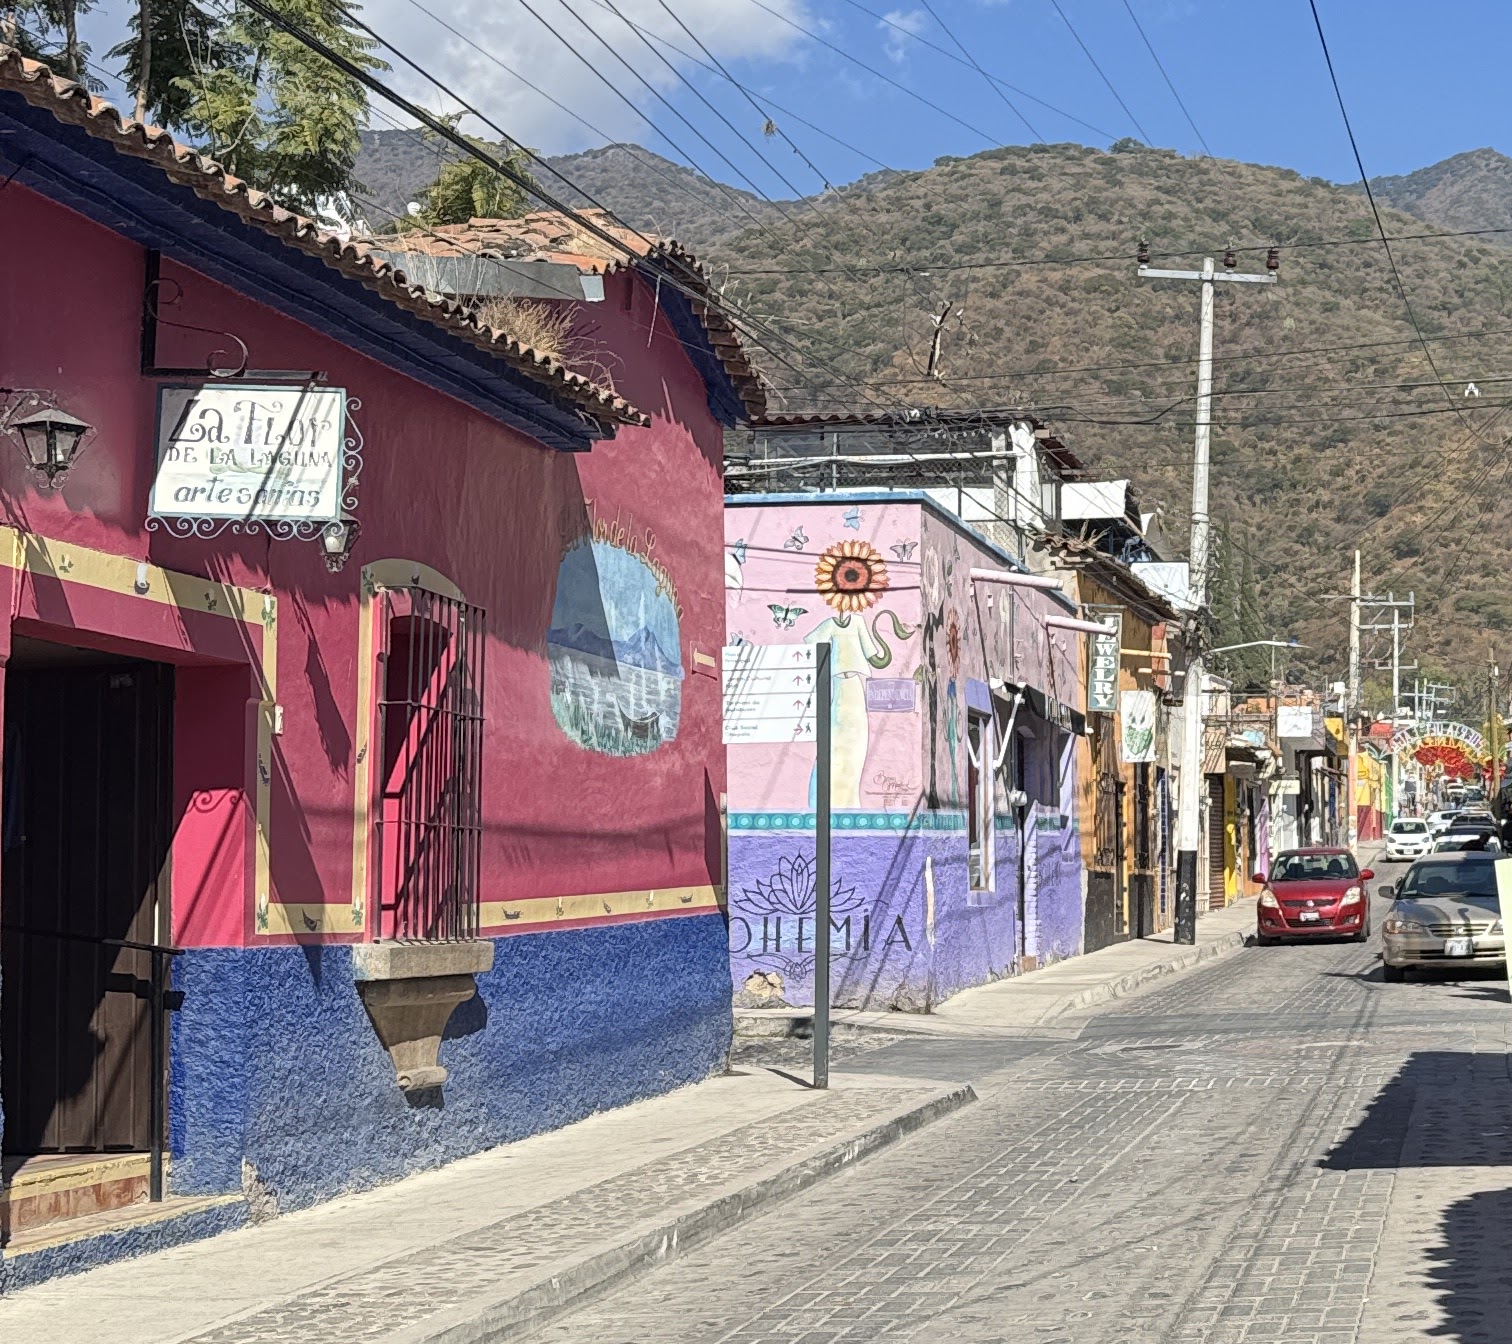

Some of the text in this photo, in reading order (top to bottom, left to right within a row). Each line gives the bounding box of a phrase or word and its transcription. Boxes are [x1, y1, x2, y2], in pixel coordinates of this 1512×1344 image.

[167, 399, 230, 444] La
[167, 446, 198, 463] DE
[209, 448, 238, 466] LA
[611, 504, 625, 549] de
[626, 513, 638, 556] la
[728, 908, 912, 954] OHEMIA
